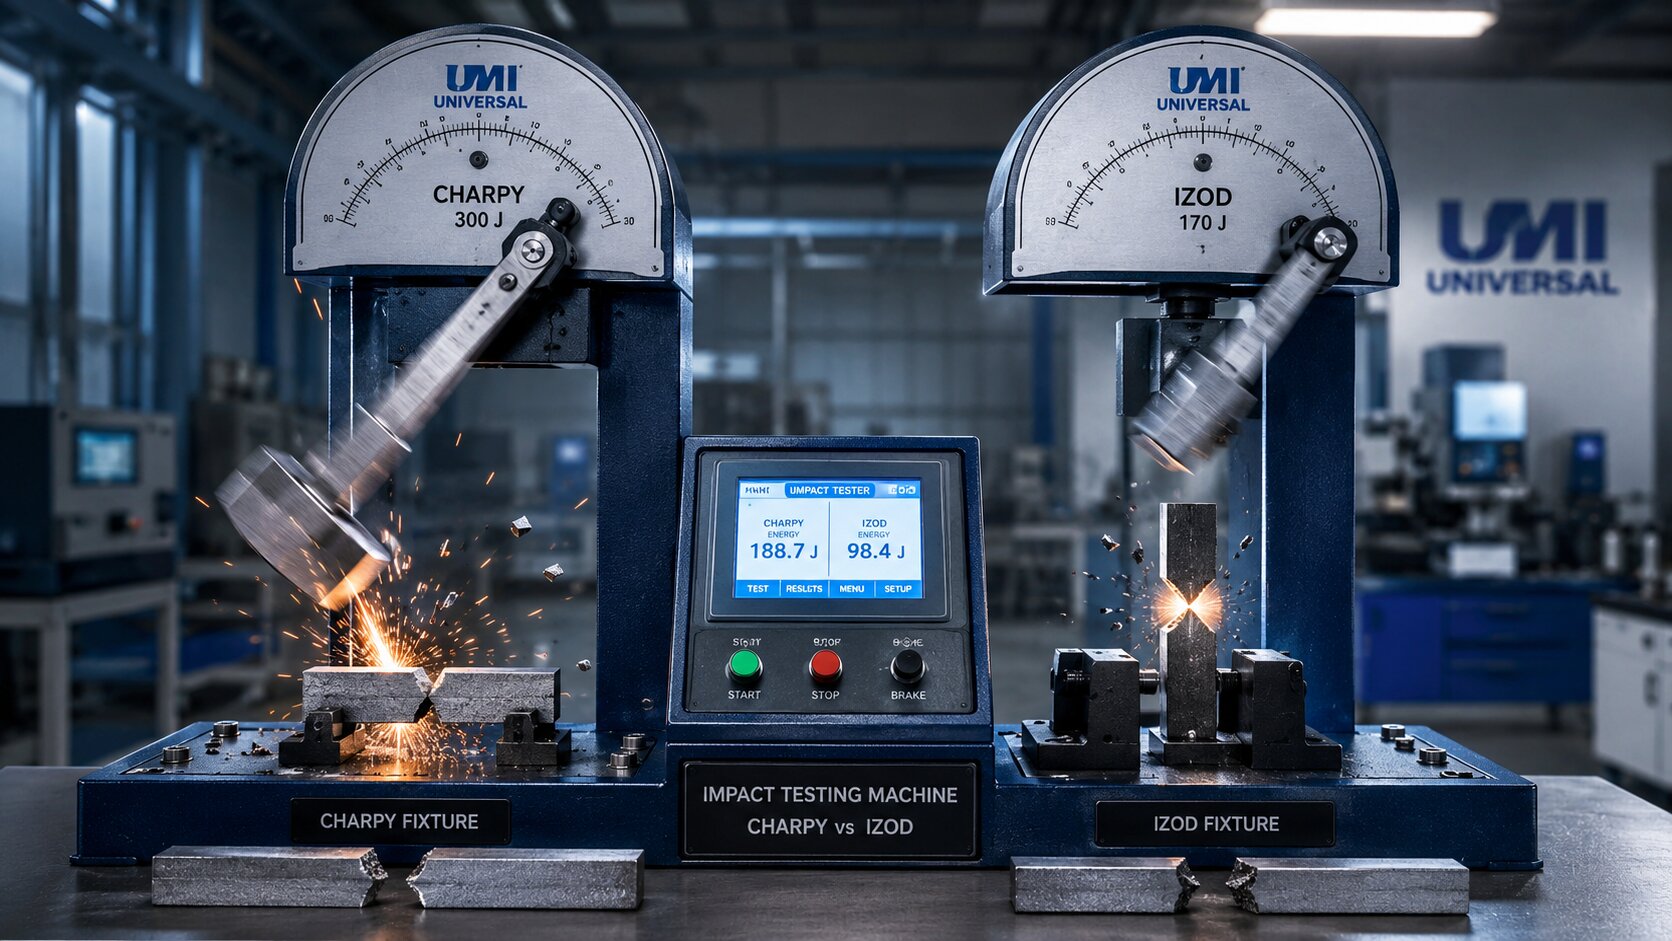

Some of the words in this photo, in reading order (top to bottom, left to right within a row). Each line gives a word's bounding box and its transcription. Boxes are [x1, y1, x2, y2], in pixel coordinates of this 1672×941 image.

[446, 65, 518, 92] UMI
[1168, 67, 1239, 94] UMI
[434, 95, 527, 108] UNIVERSAL
[1157, 98, 1250, 111] UNIVERSAL
[434, 185, 524, 203] CHARPY
[1176, 188, 1232, 206] IZOD
[455, 212, 488, 227] 300
[494, 212, 502, 227] J
[1180, 215, 1212, 230] 170
[1218, 215, 1226, 230] J
[1439, 199, 1608, 263] UMI
[1427, 268, 1620, 296] UNIVERSAL
[764, 519, 803, 527] CHARPY
[863, 519, 886, 527] IZOD
[751, 543, 804, 558] 188.7
[810, 545, 817, 558] J
[848, 543, 891, 558] 98.4
[897, 546, 904, 558] J
[728, 690, 761, 699] START
[812, 691, 839, 699] STOP
[891, 691, 926, 699] BRAKE
[704, 787, 775, 802] IMPACT
[781, 787, 861, 802] TESTING
[869, 787, 957, 802] MACHINE
[321, 813, 396, 828] CHARPY
[403, 814, 478, 829] FIXTURE
[748, 819, 827, 834] CHARPY
[835, 823, 854, 834] vs
[867, 819, 913, 834] IZOD
[1155, 816, 1197, 831] IZOD
[1205, 816, 1279, 831] FIXTURE
